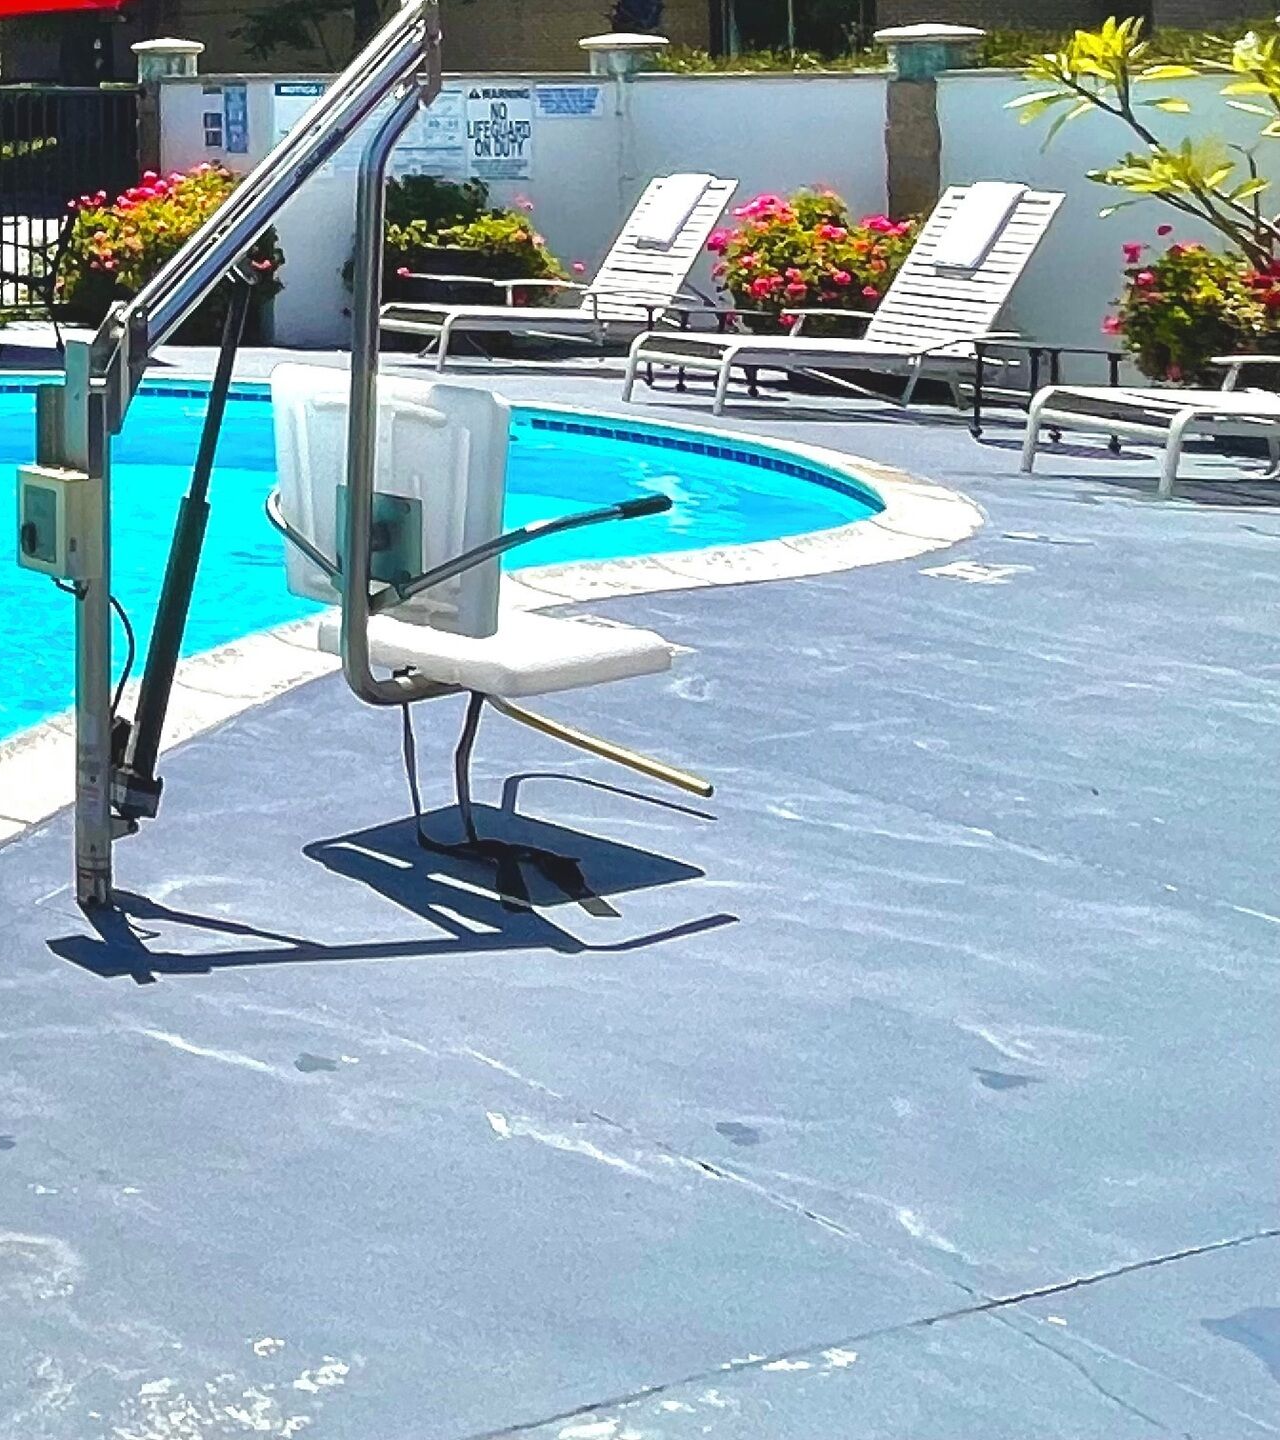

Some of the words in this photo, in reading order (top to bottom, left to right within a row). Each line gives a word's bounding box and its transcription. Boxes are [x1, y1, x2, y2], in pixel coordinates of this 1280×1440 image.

[482, 89, 530, 99] WARNING
[490, 102, 507, 119] NO
[467, 120, 531, 139] LIFEGUARD
[475, 139, 491, 157] ON
[493, 139, 524, 157] DUTY
